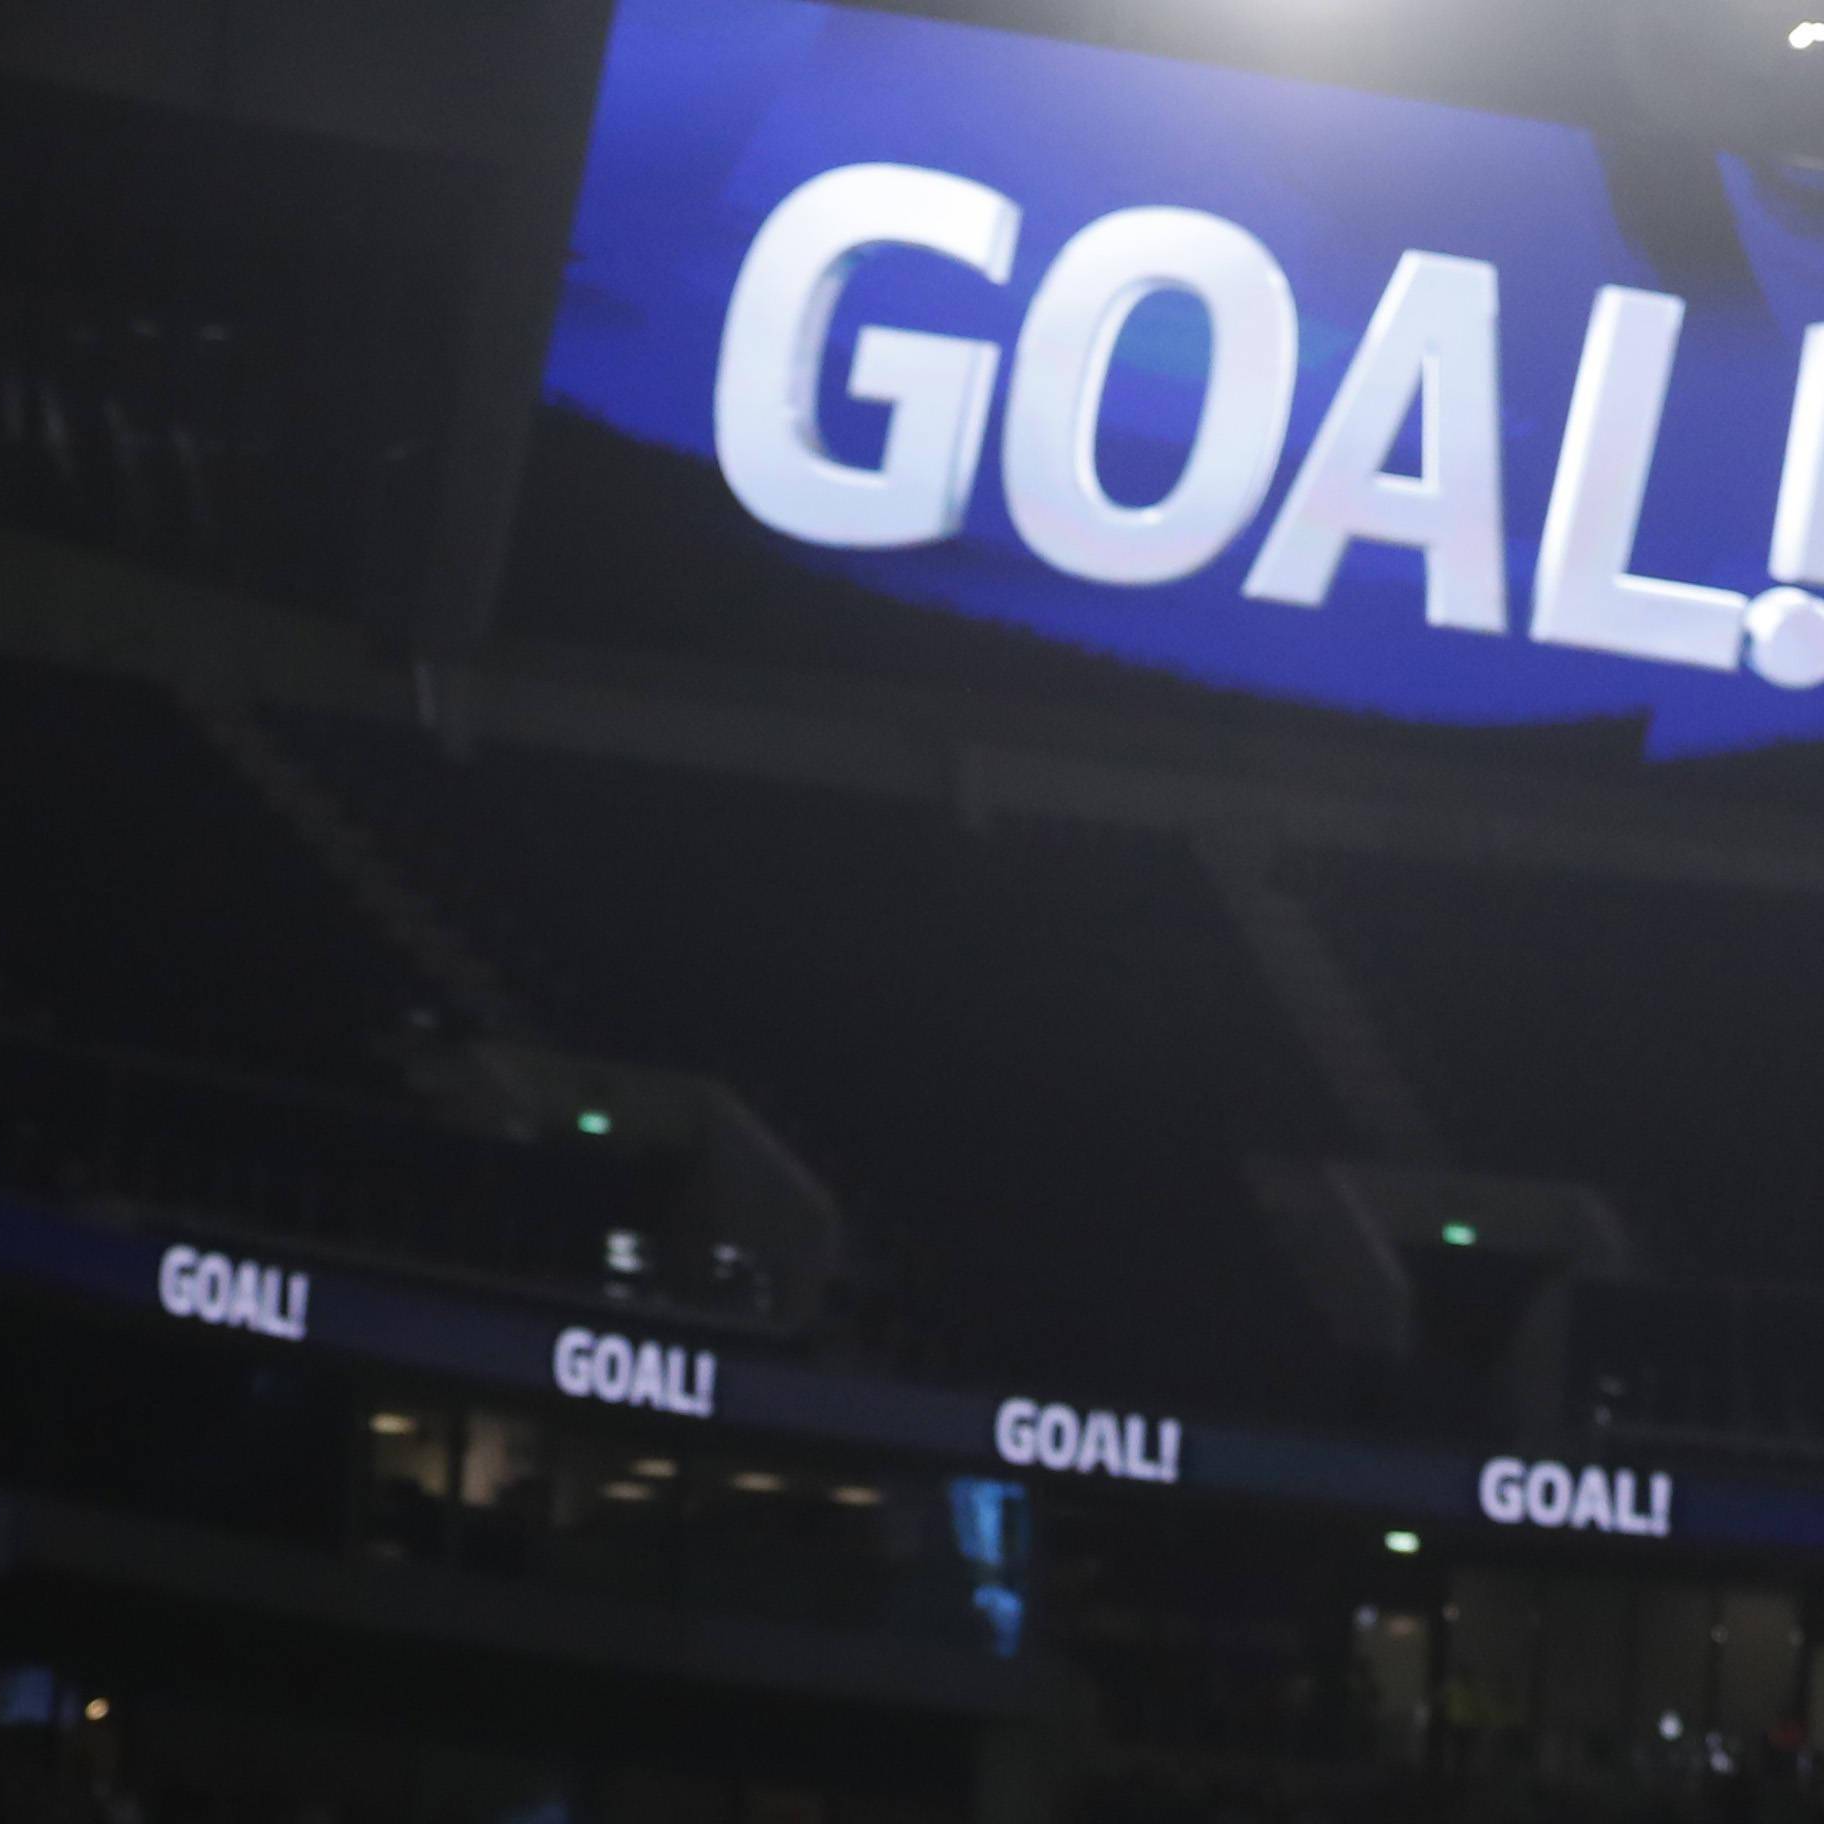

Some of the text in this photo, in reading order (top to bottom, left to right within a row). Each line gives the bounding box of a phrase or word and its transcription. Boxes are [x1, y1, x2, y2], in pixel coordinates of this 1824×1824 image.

[158, 1243, 310, 1342] GOAL!
[553, 1326, 717, 1419] GOAL!
[994, 1396, 1183, 1485] GOAL!
[1478, 1455, 1674, 1538] GOAL!
